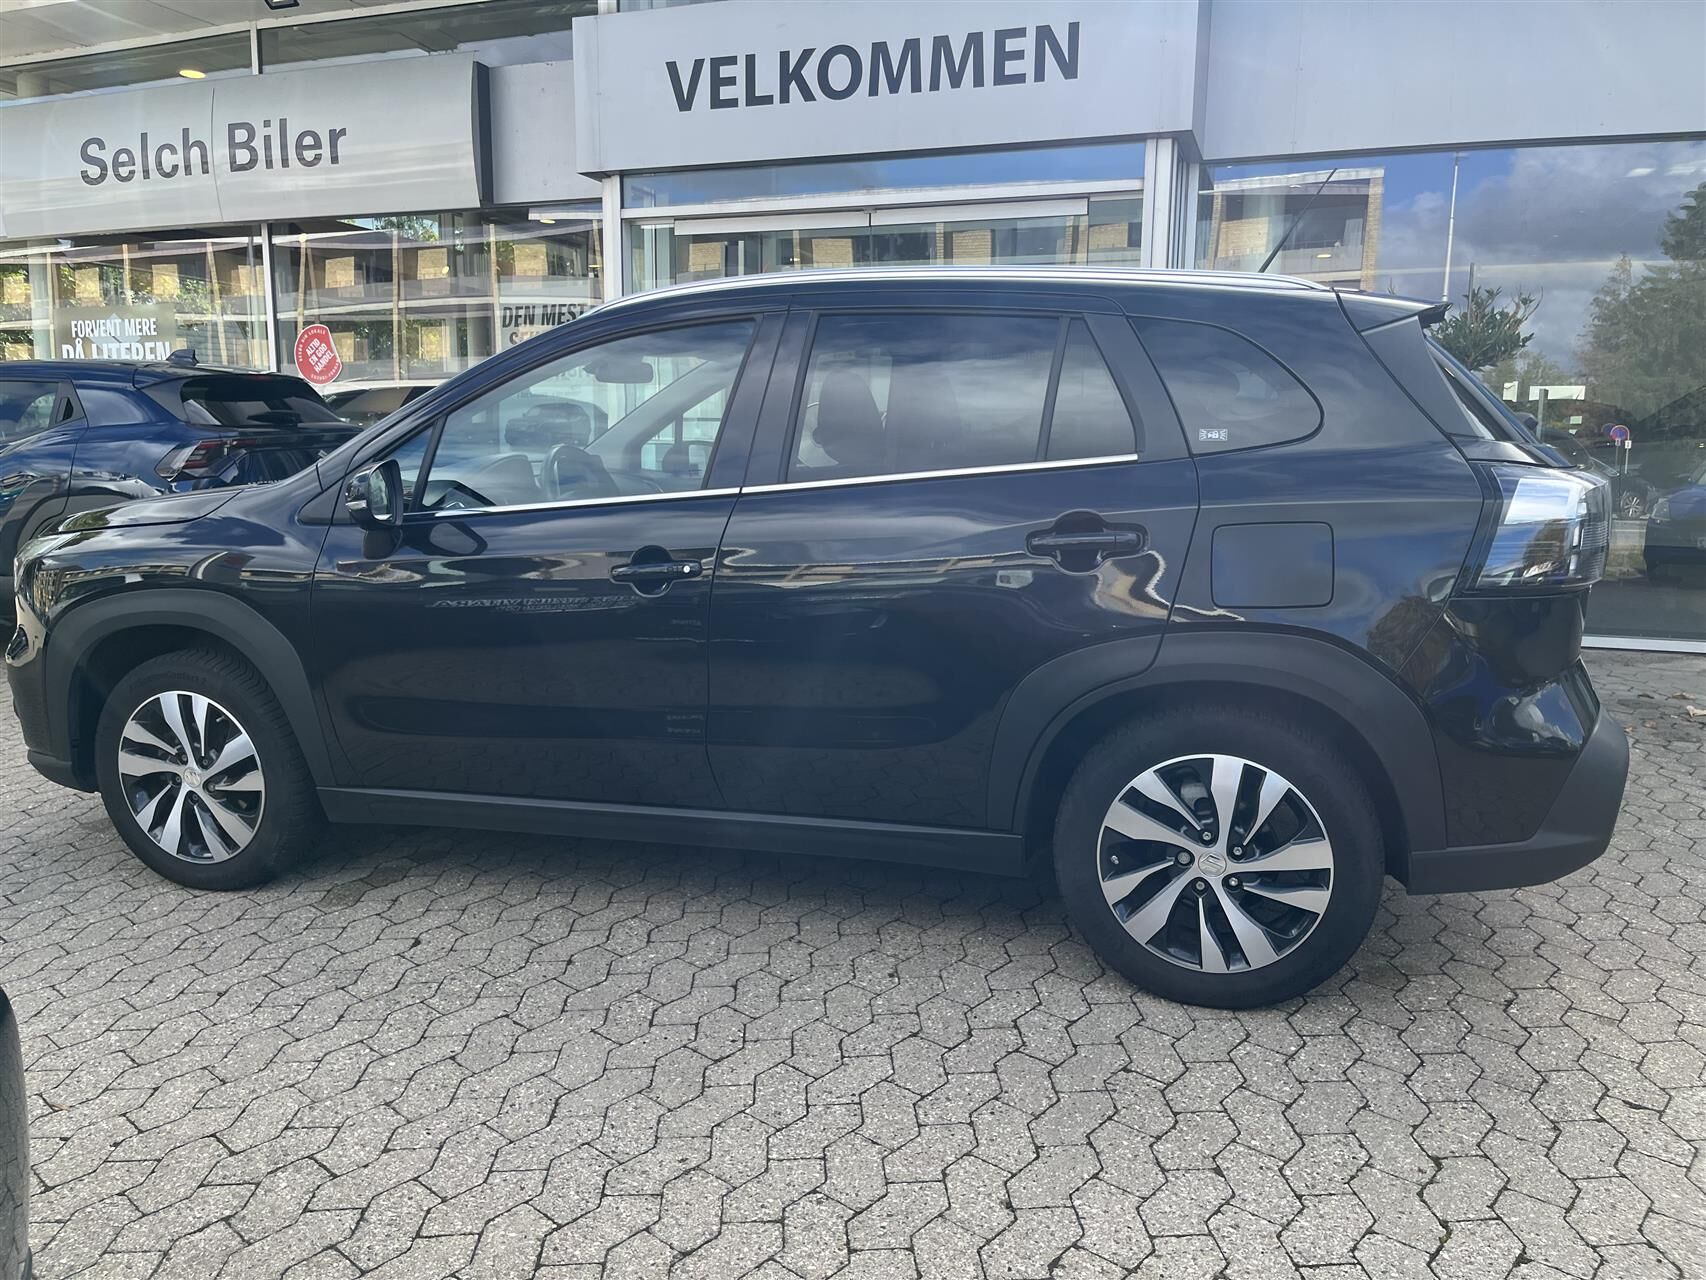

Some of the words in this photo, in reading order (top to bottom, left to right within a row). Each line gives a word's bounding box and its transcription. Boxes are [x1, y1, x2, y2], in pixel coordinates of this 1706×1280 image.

[665, 21, 1081, 113] VELKOMMEN
[79, 127, 210, 186] Selch
[227, 117, 347, 173] Biler
[71, 319, 121, 338] FORVENT
[125, 317, 158, 336] MERE
[502, 305, 536, 328] DEN
